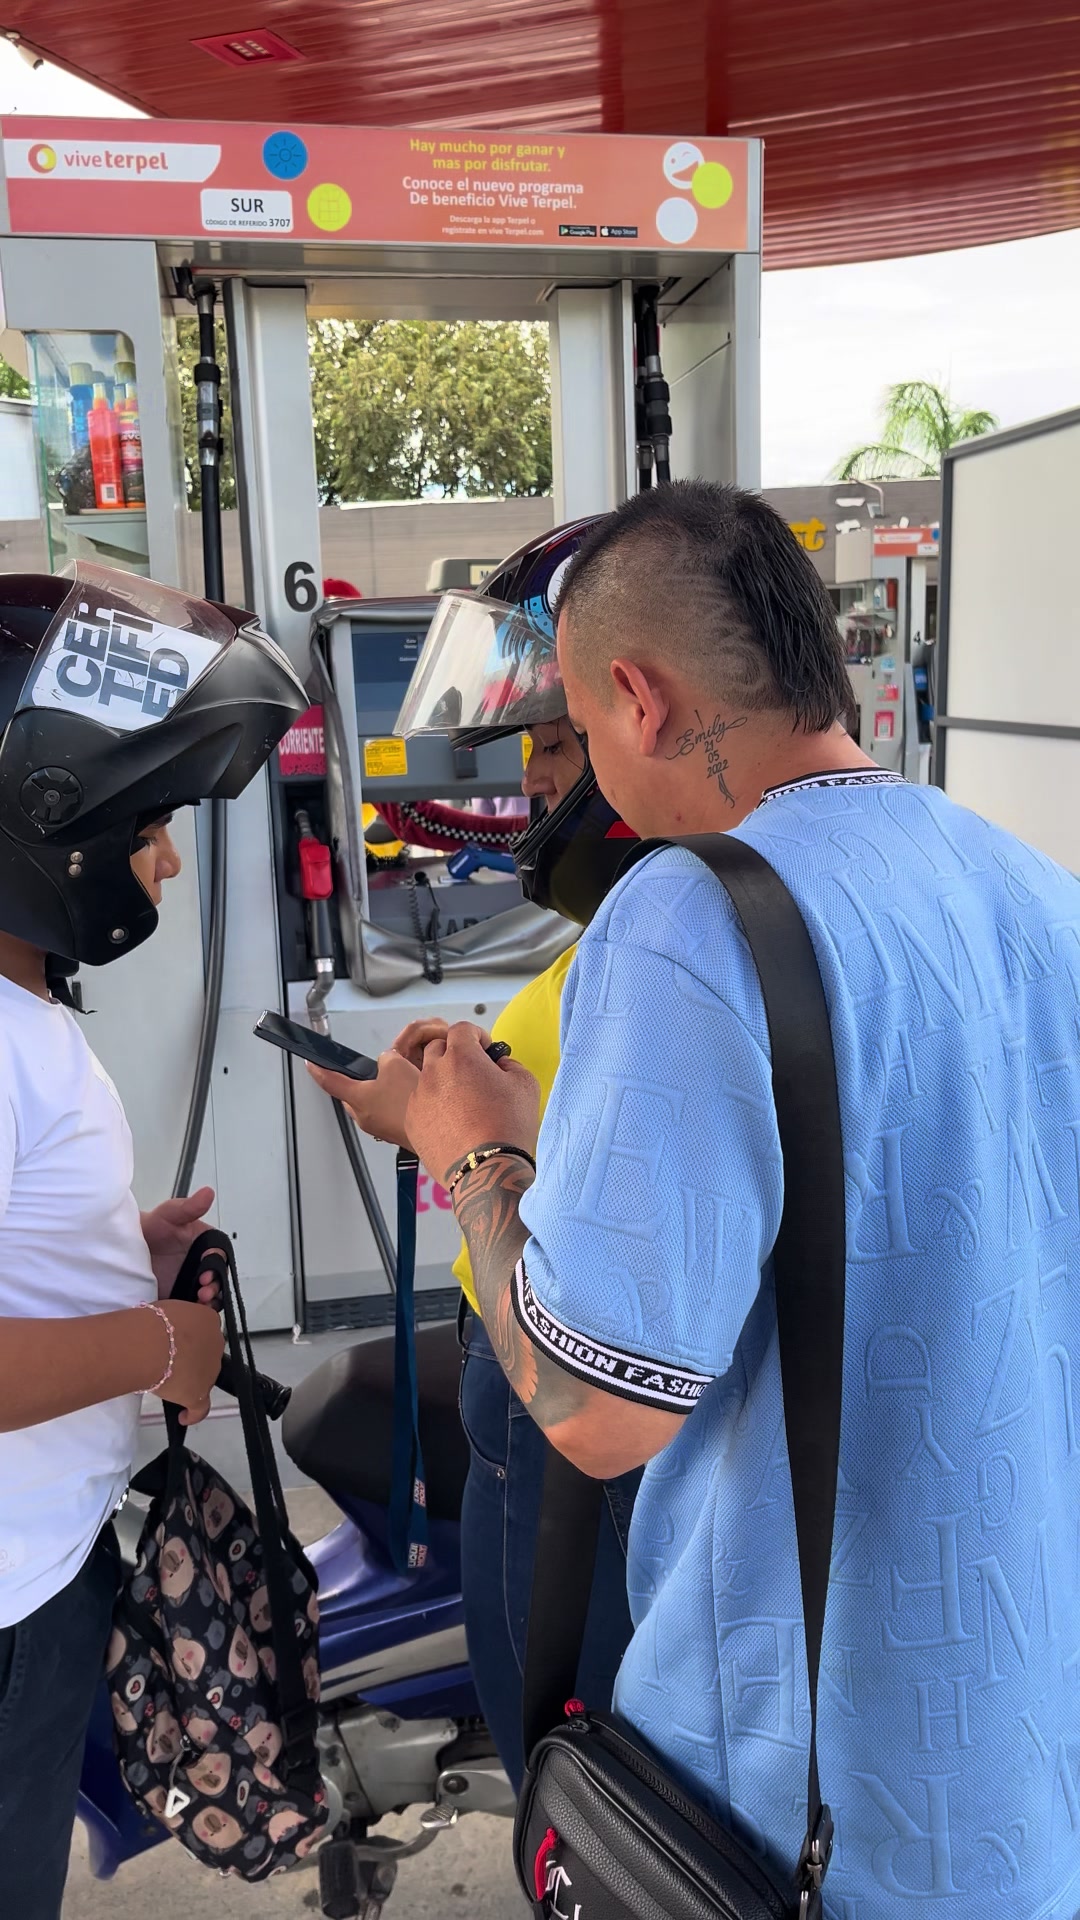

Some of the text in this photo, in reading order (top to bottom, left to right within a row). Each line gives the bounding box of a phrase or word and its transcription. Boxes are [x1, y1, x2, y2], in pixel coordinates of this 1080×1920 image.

[410, 139, 566, 159] Hay mucho por ganar y
[104, 150, 169, 174] terpel
[432, 158, 552, 173] mas por disfrutar.
[402, 176, 584, 196] Conoce el nuevo programa
[230, 197, 265, 213] SUR
[410, 191, 577, 211] De beneficio Vive Terpel.
[268, 218, 291, 228] 3707
[449, 214, 483, 225] Descarga
[483, 215, 491, 224] la
[491, 217, 506, 226] app
[506, 216, 530, 226] Terpel
[488, 227, 503, 235] vive
[610, 228, 637, 236] App Store
[284, 561, 318, 613] 6
[278, 727, 325, 755] CORRIENTE
[665, 713, 748, 760] Emily
[704, 740, 714, 753] 21
[707, 750, 720, 764] 05
[706, 759, 729, 779] 2022
